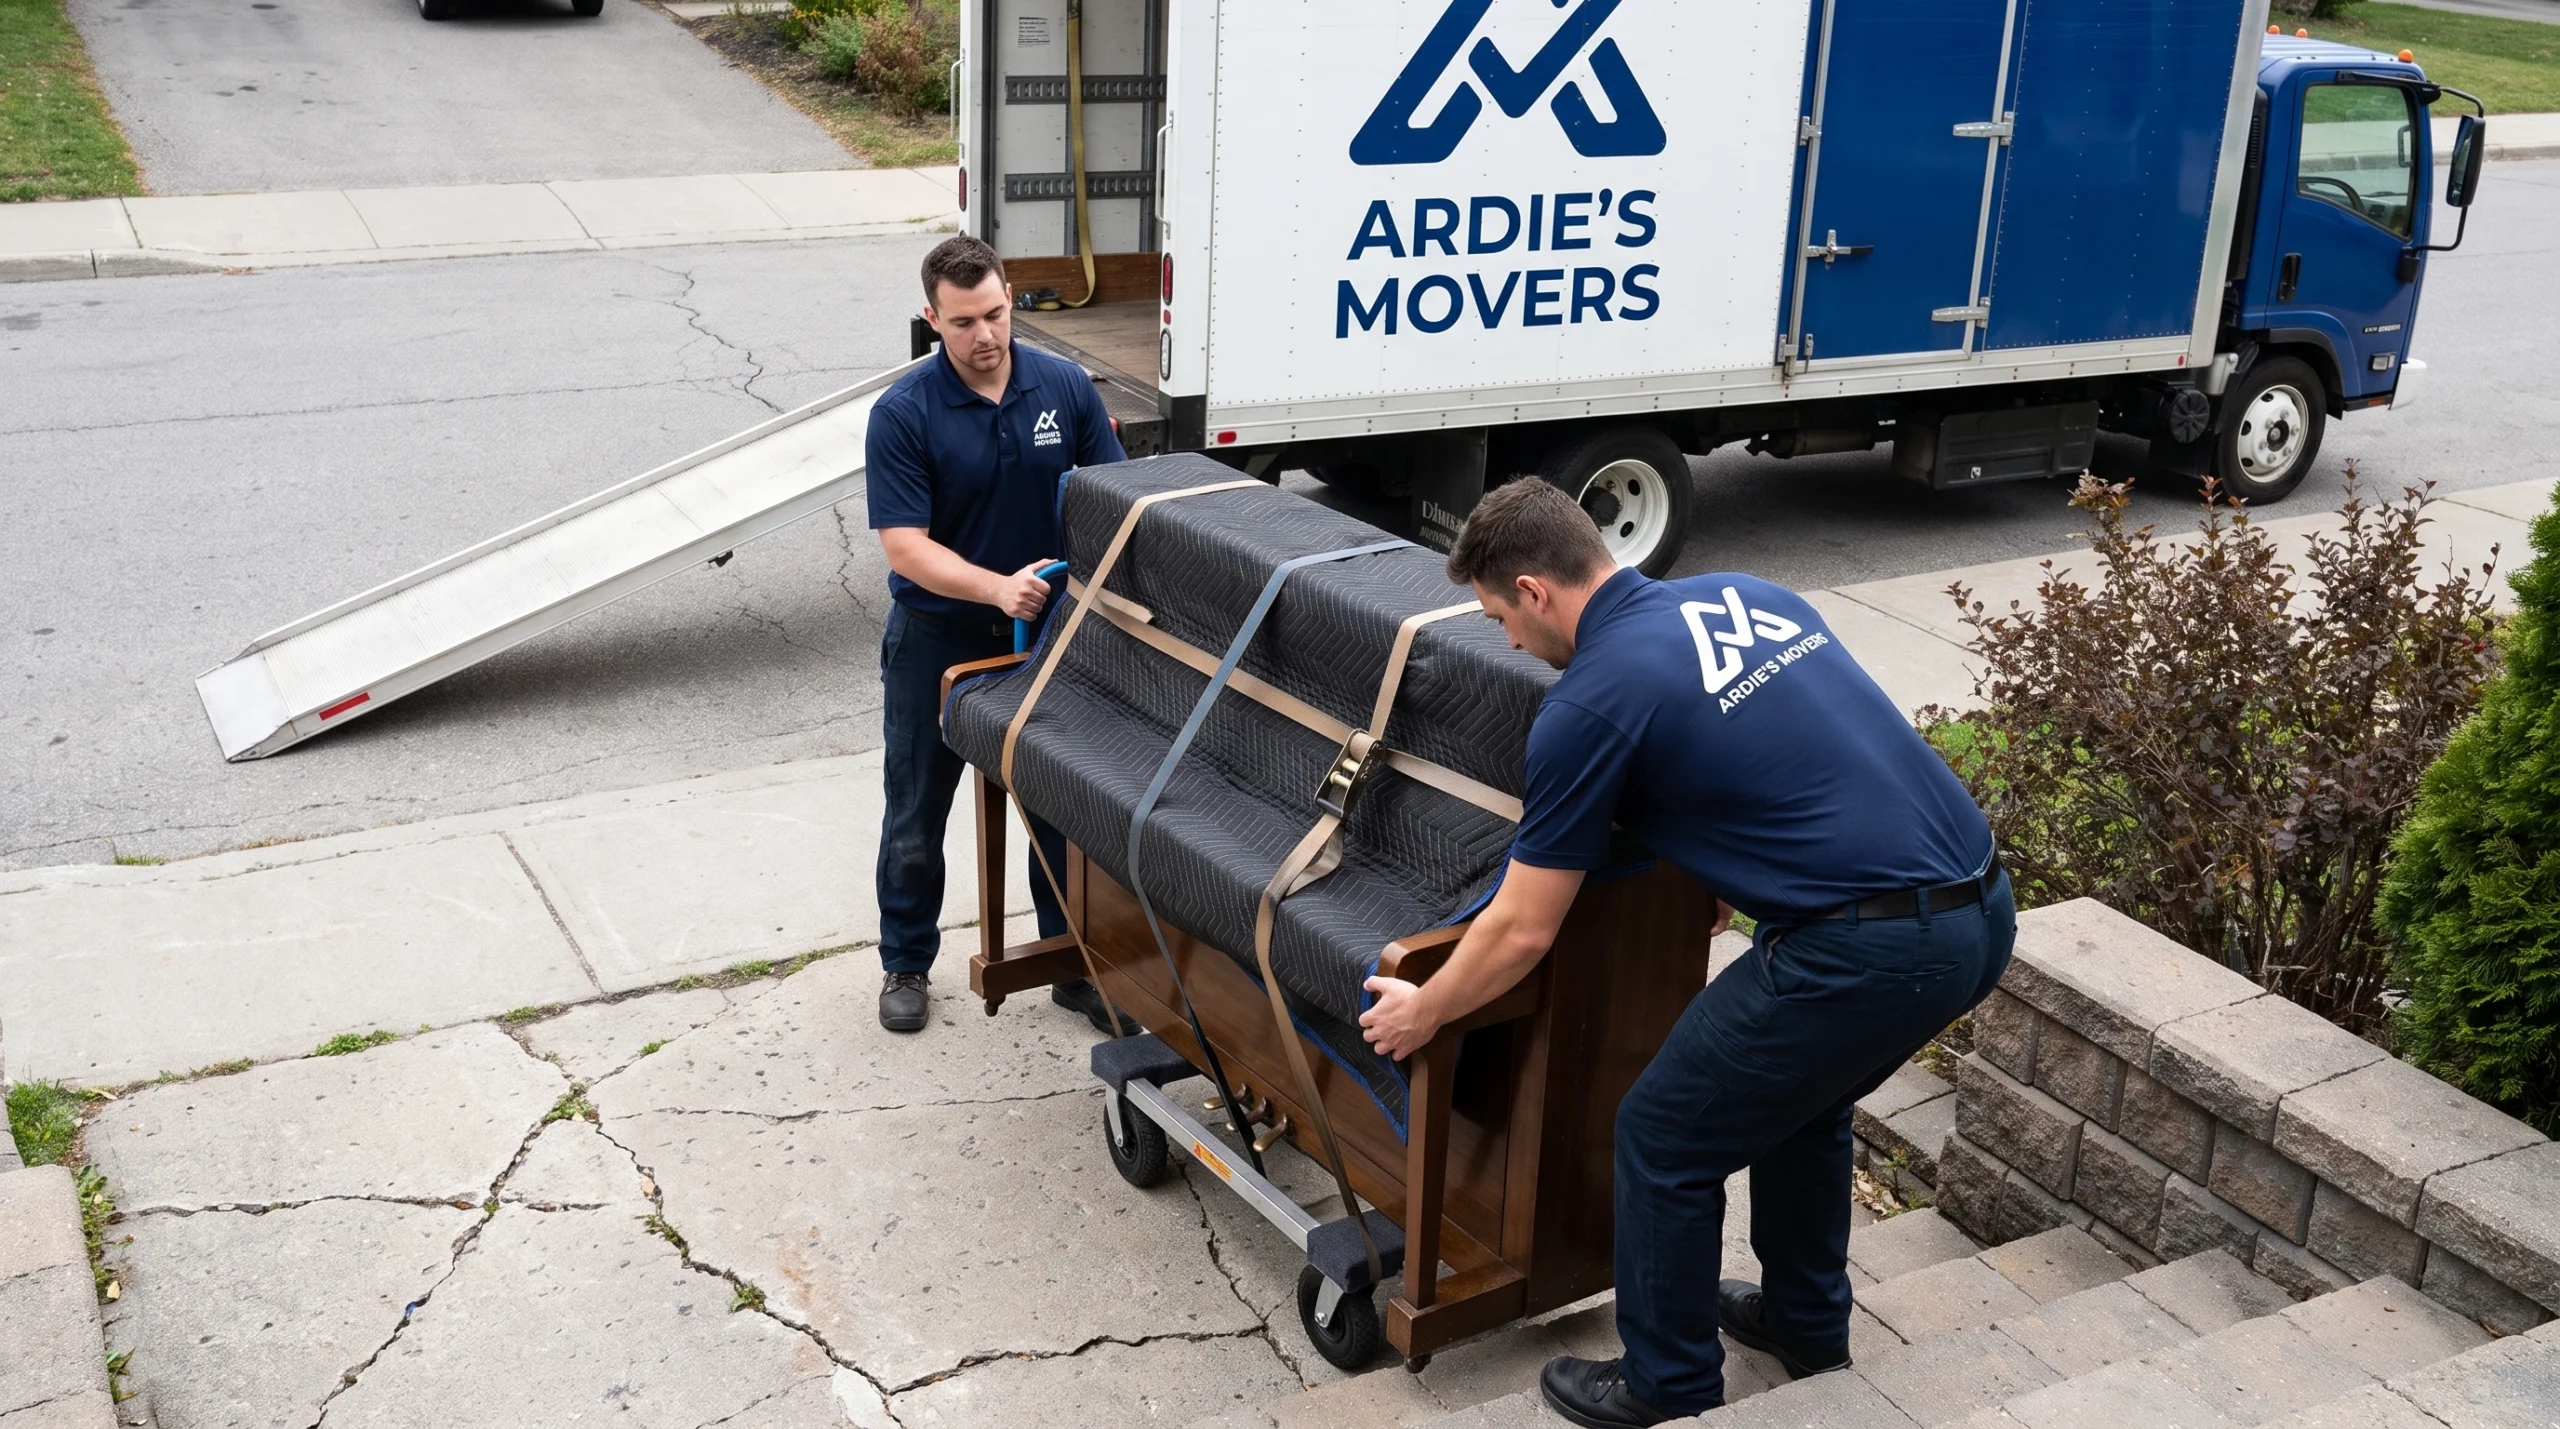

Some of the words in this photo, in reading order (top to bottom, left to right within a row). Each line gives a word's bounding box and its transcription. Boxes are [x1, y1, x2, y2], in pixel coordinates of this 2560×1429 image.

[1346, 188, 1657, 260] ARDIE’S
[1335, 263, 1660, 339] MOVERS
[1718, 660, 1781, 714] ARDIE'S
[1775, 632, 1829, 666] MOVERS
